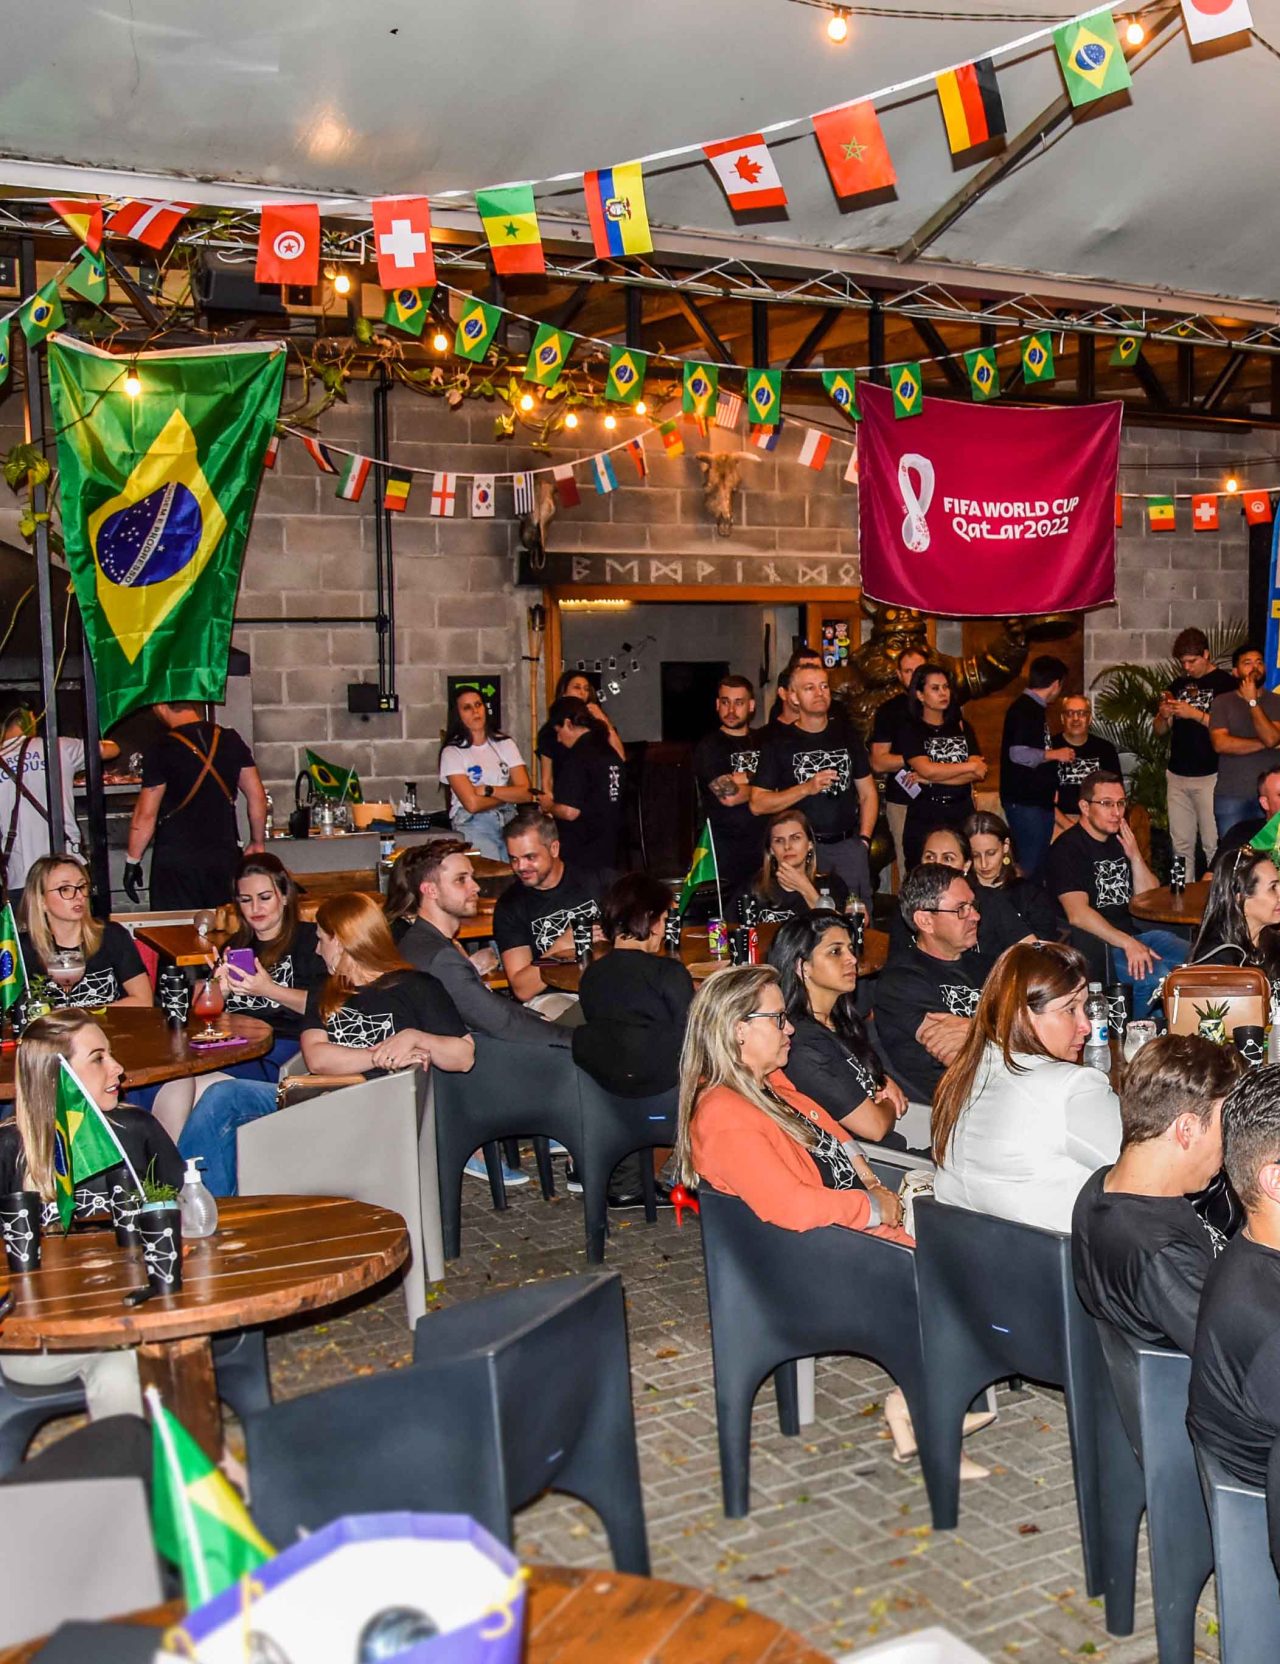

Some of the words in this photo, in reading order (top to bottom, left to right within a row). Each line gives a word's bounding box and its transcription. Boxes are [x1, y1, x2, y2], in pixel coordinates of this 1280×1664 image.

[943, 496, 982, 517] FIFA
[982, 500, 1050, 518] WORLD
[1052, 496, 1080, 515] CUP
